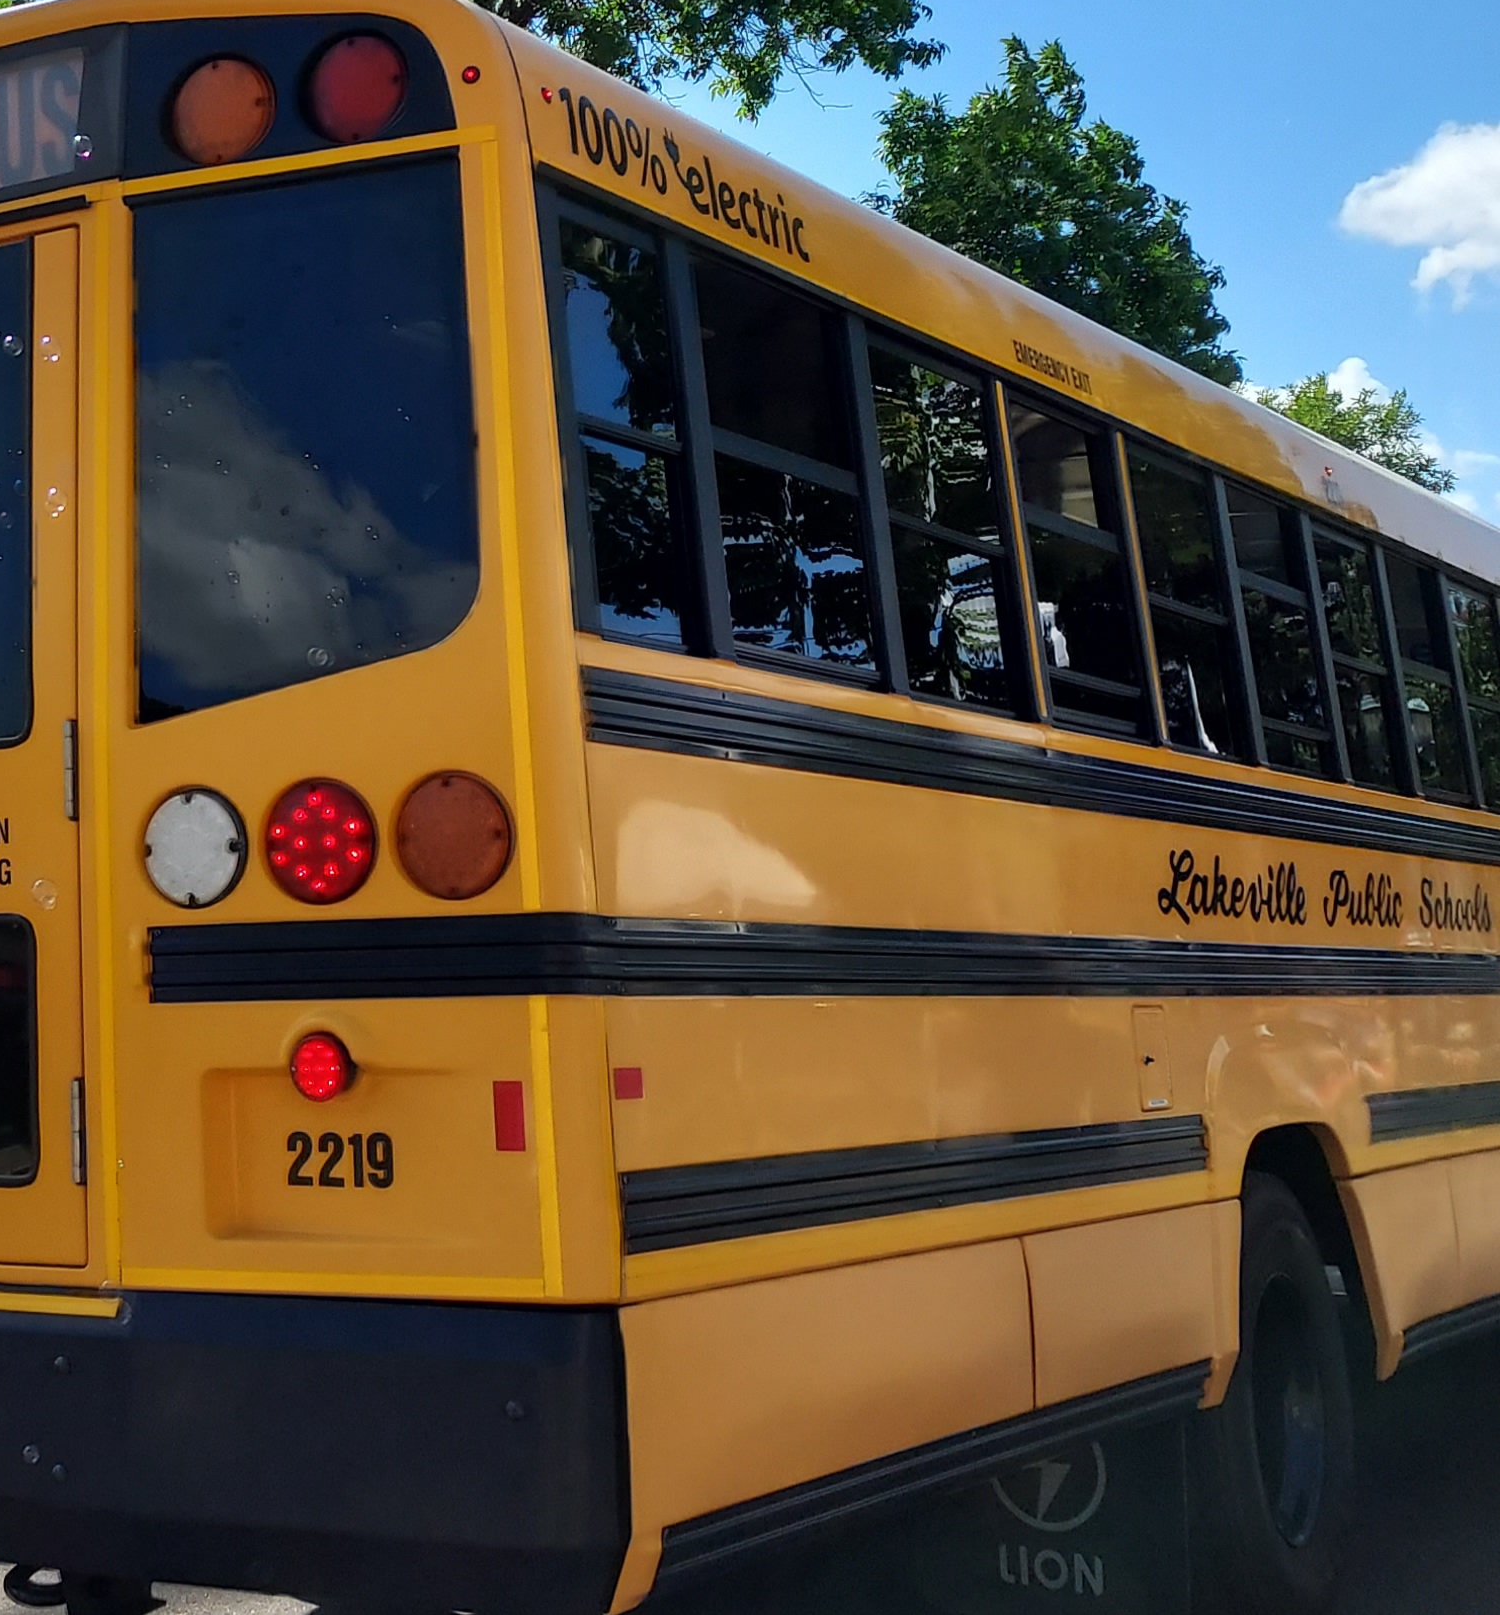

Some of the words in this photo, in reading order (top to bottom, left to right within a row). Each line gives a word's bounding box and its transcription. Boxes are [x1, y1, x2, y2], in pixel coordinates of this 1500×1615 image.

[559, 87, 667, 195] 100%
[686, 156, 810, 263] electric
[1012, 339, 1071, 385] EMERGENCY
[1070, 367, 1093, 395] EXIT
[1158, 849, 1306, 925] Lakeville
[1323, 870, 1403, 927] Public
[1420, 877, 1492, 932] Schools
[286, 1131, 394, 1188] 2219
[999, 1543, 1104, 1597] LION
